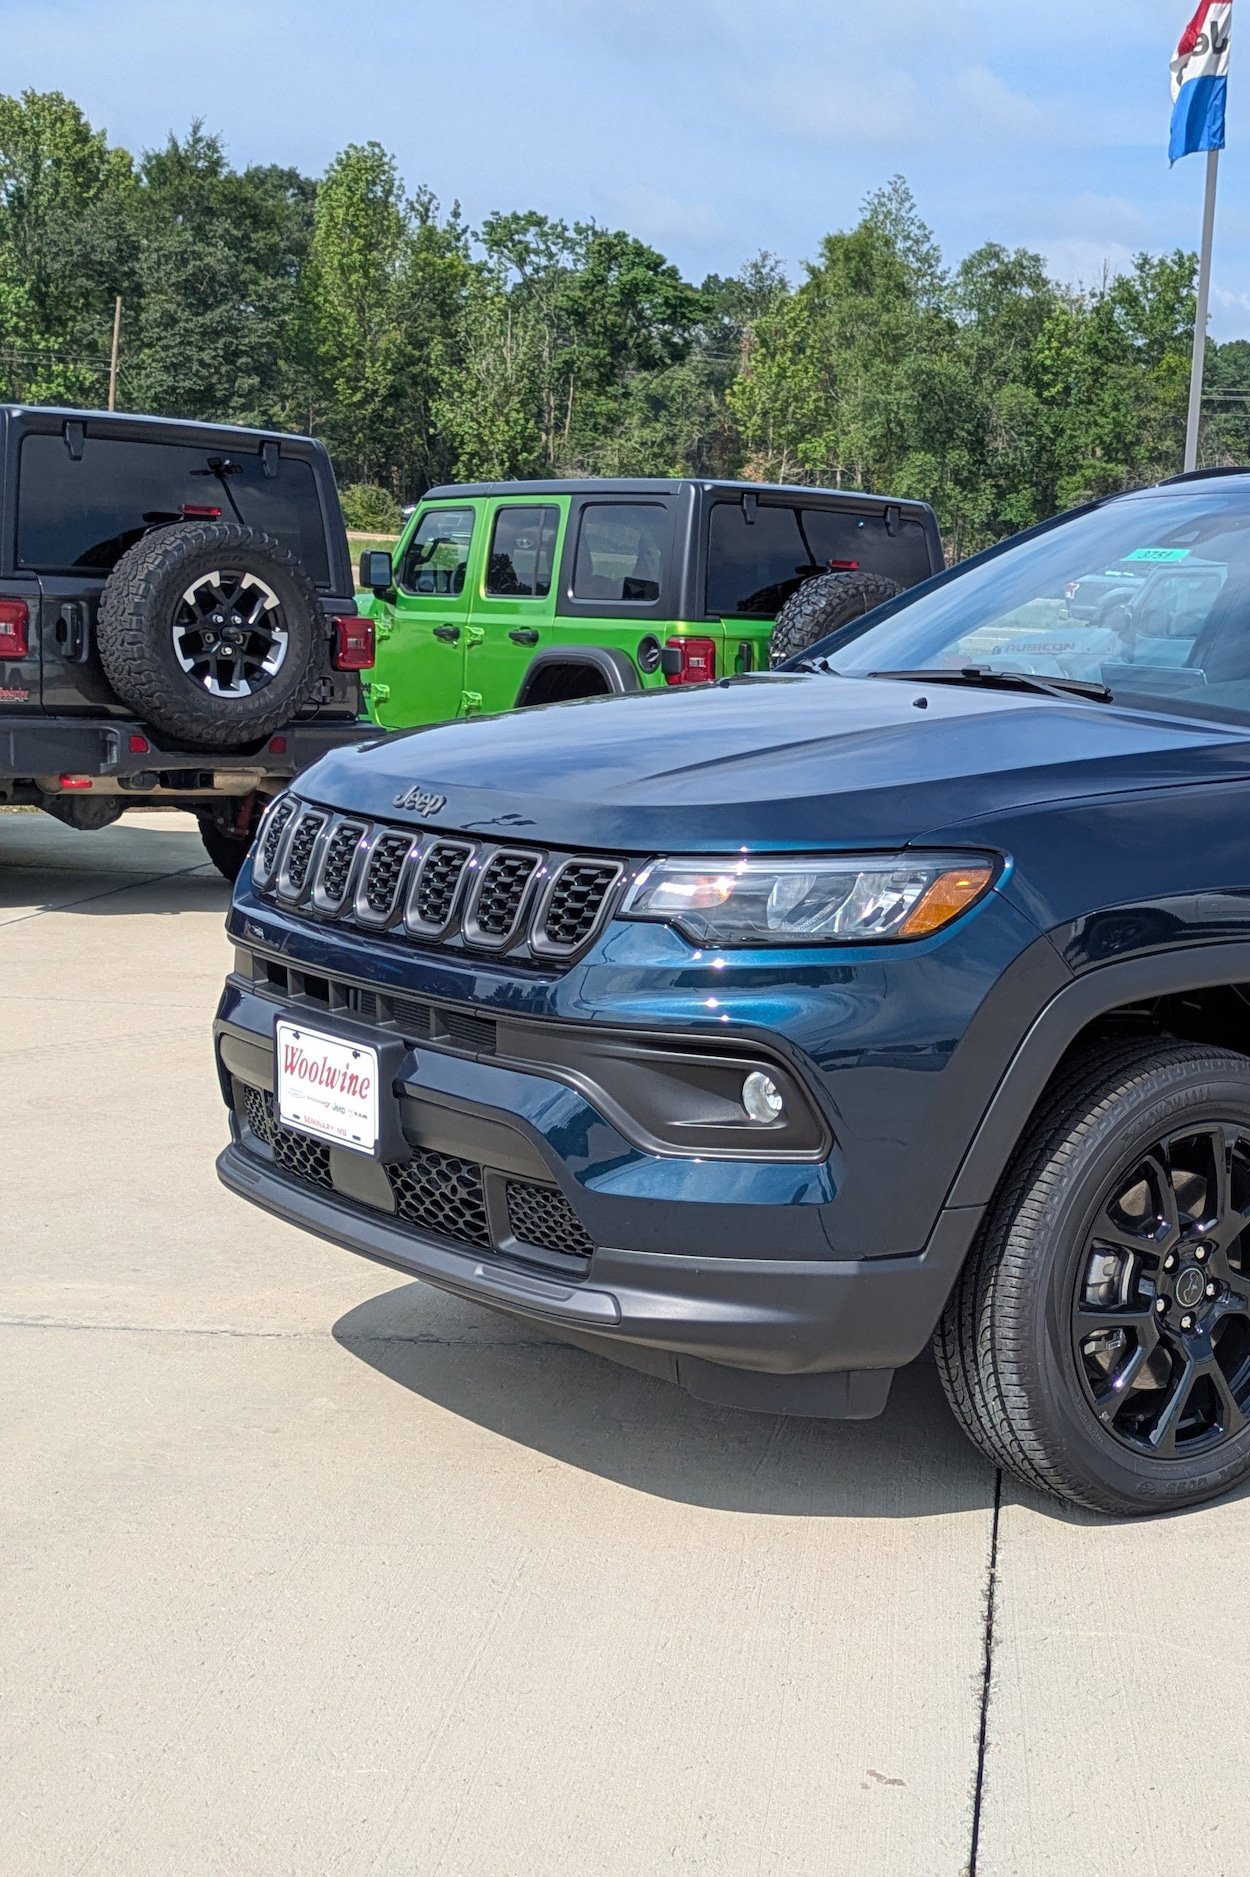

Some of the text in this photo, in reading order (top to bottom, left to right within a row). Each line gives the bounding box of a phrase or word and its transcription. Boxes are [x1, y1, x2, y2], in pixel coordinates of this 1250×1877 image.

[1006, 642, 1075, 653] RUBICON
[392, 785, 447, 818] Jeep
[284, 1044, 371, 1101] Woolwine
[332, 1102, 346, 1115] Jeep
